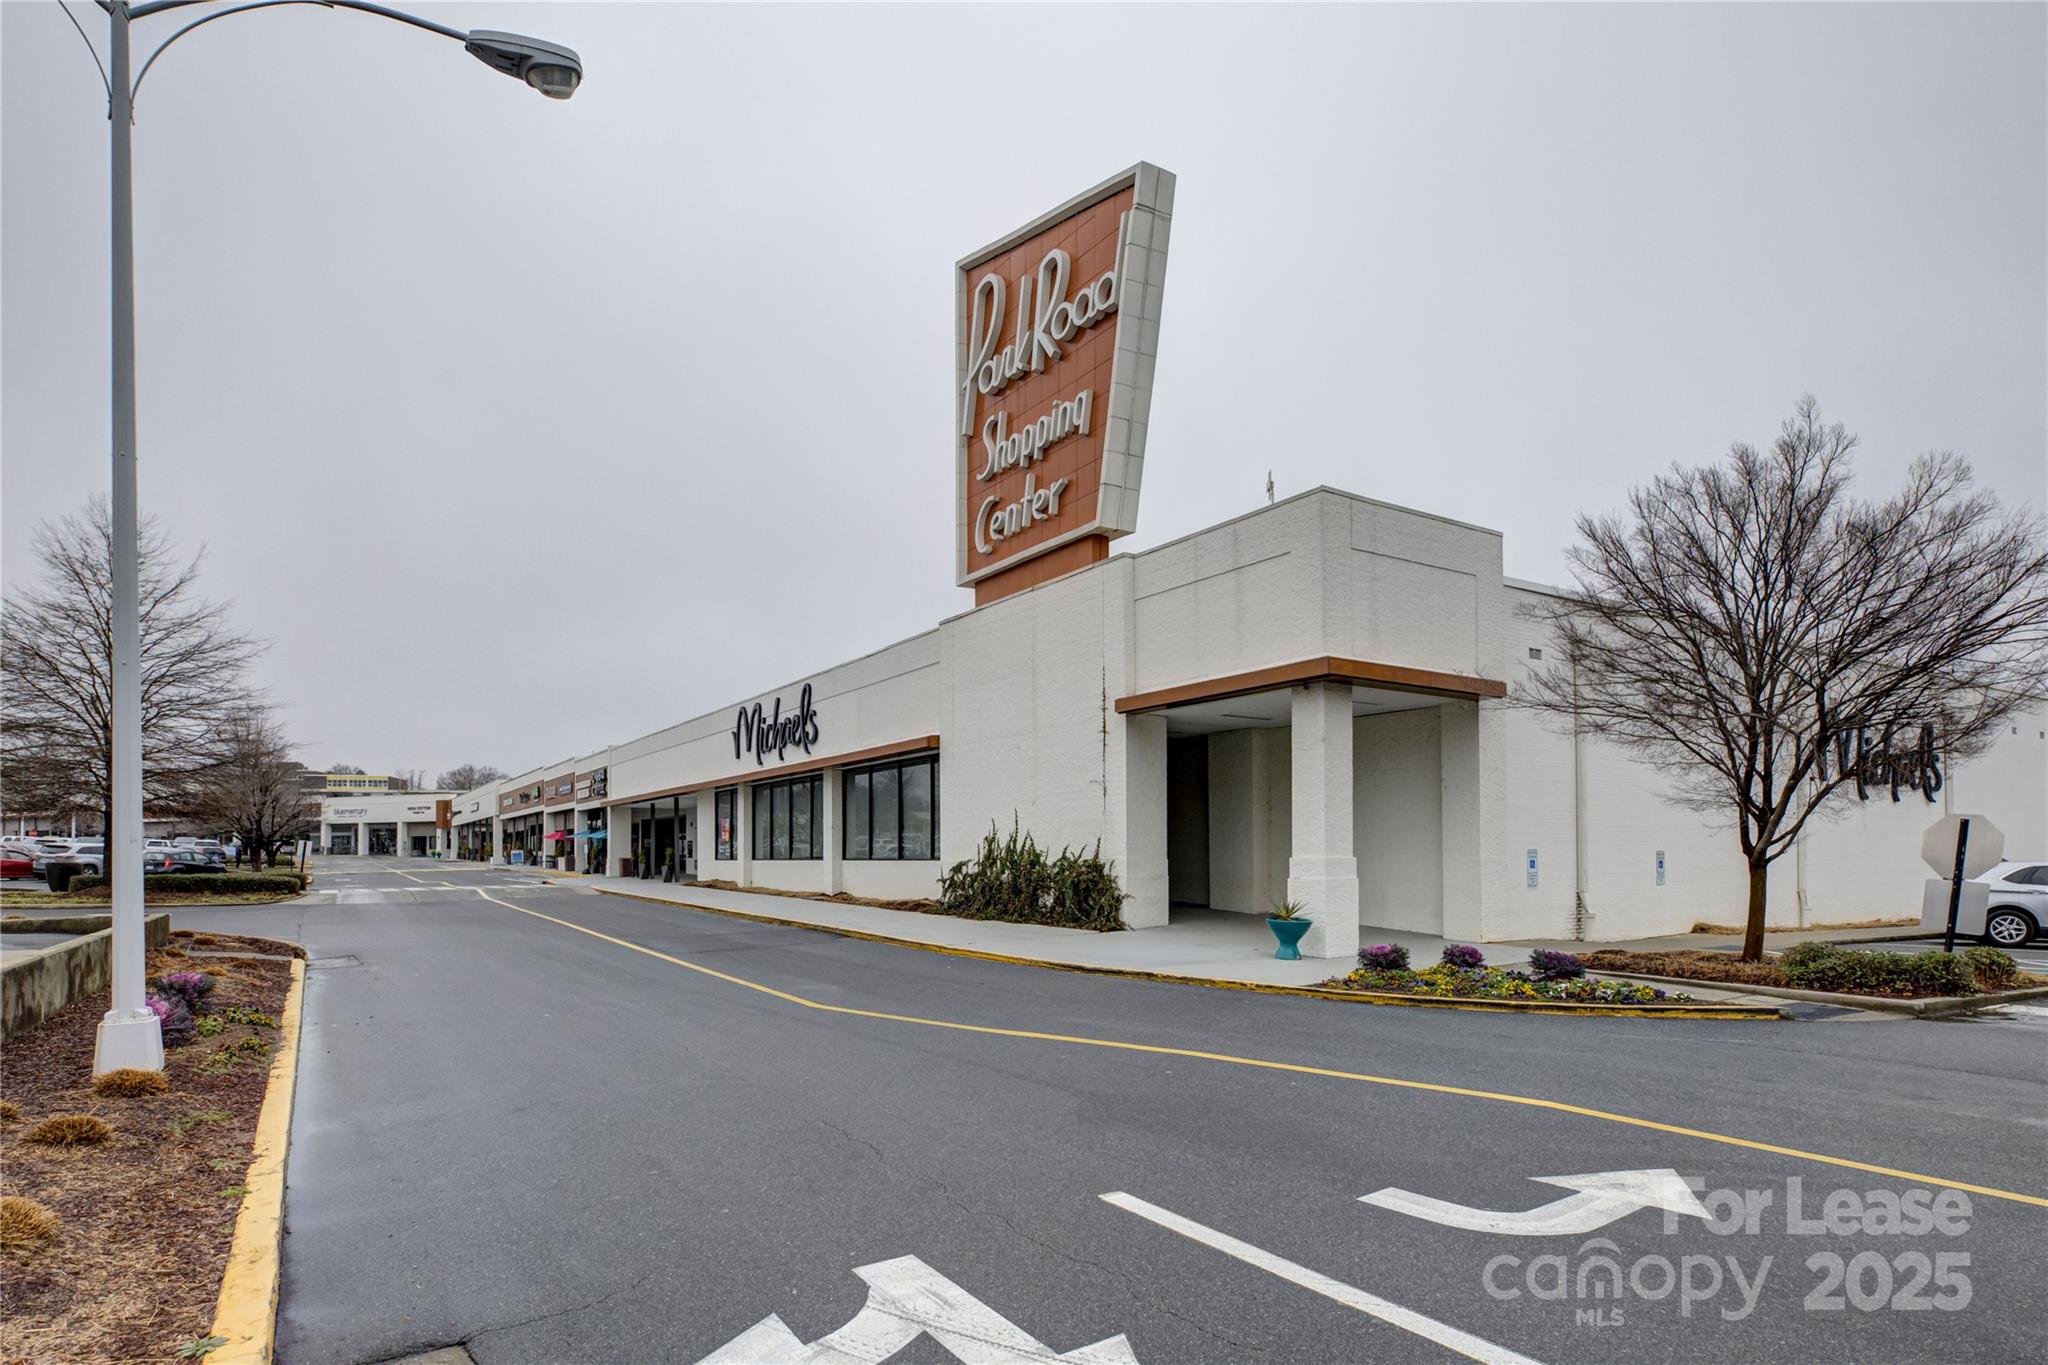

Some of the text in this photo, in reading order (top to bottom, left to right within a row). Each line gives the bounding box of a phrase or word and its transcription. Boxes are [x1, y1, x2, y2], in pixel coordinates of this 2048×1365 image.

[963, 211, 1128, 437] Park Road
[976, 389, 1093, 482] Shopping
[974, 473, 1068, 555] Center
[731, 683, 819, 765] Michaels
